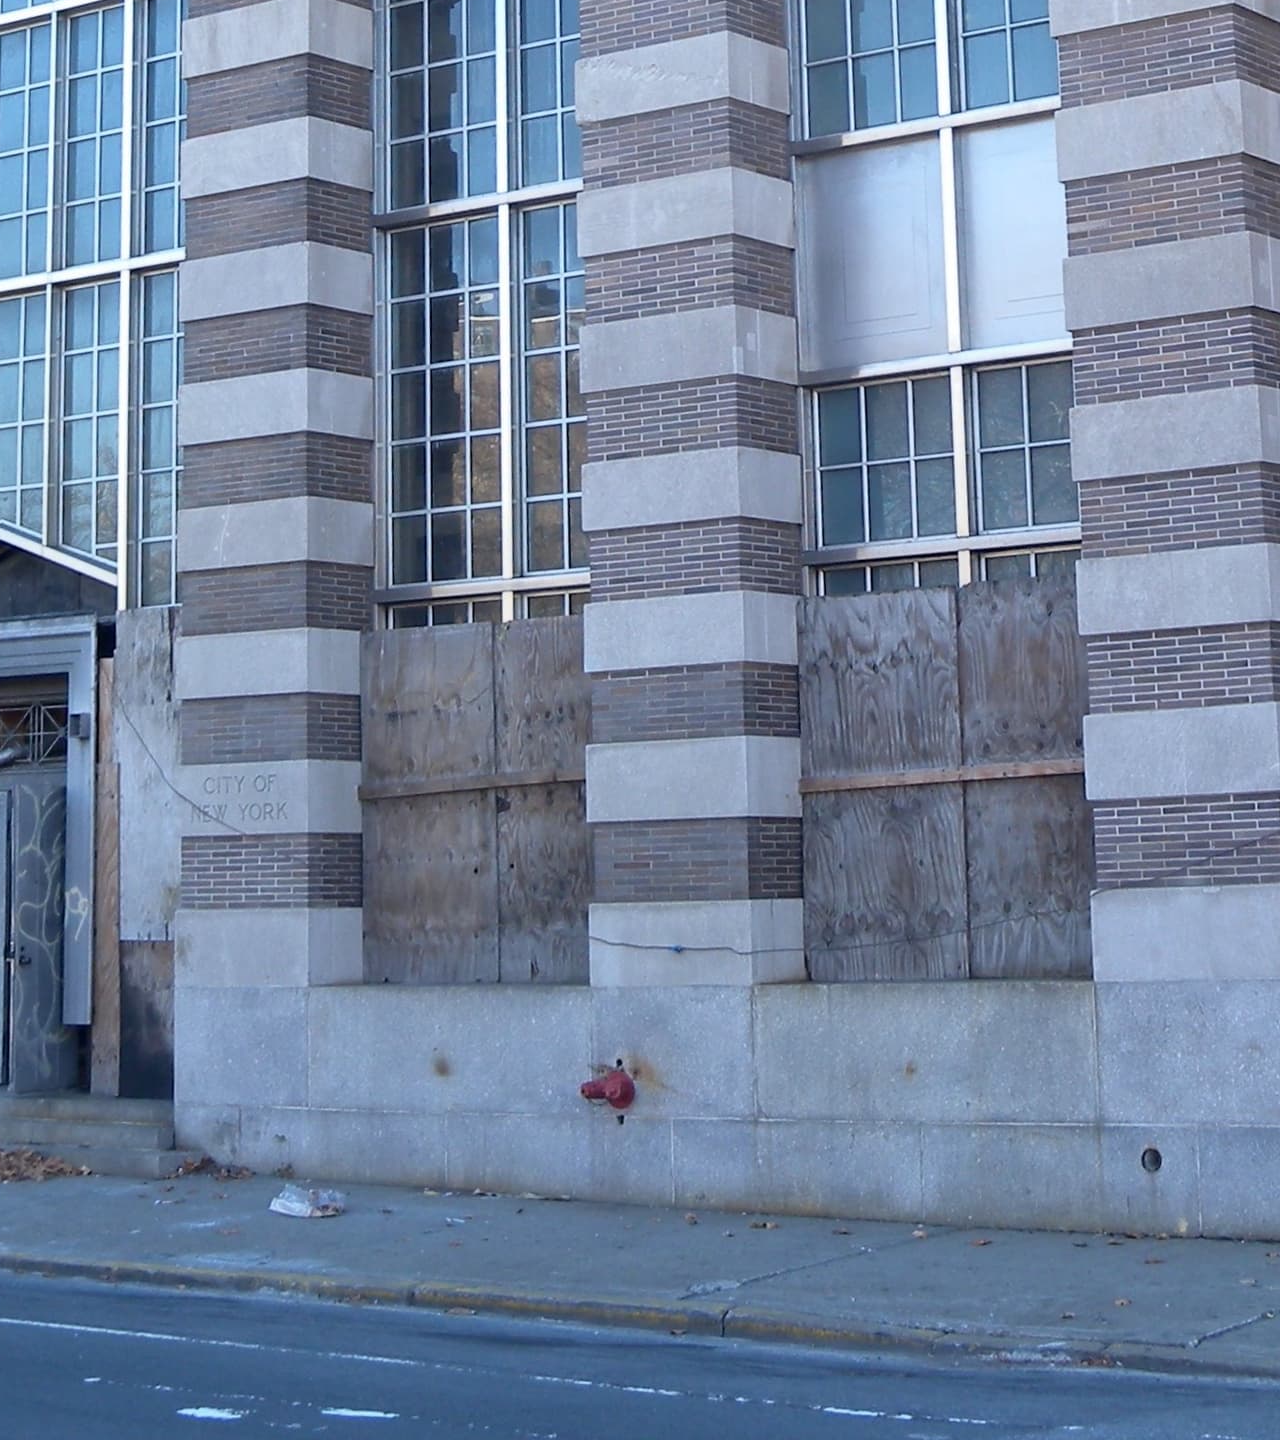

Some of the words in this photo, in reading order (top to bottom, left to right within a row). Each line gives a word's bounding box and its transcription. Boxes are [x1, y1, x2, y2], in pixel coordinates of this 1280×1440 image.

[203, 775, 246, 795] CITY
[254, 773, 277, 793] OF
[191, 803, 228, 824] NEW
[238, 800, 288, 822] YORK
